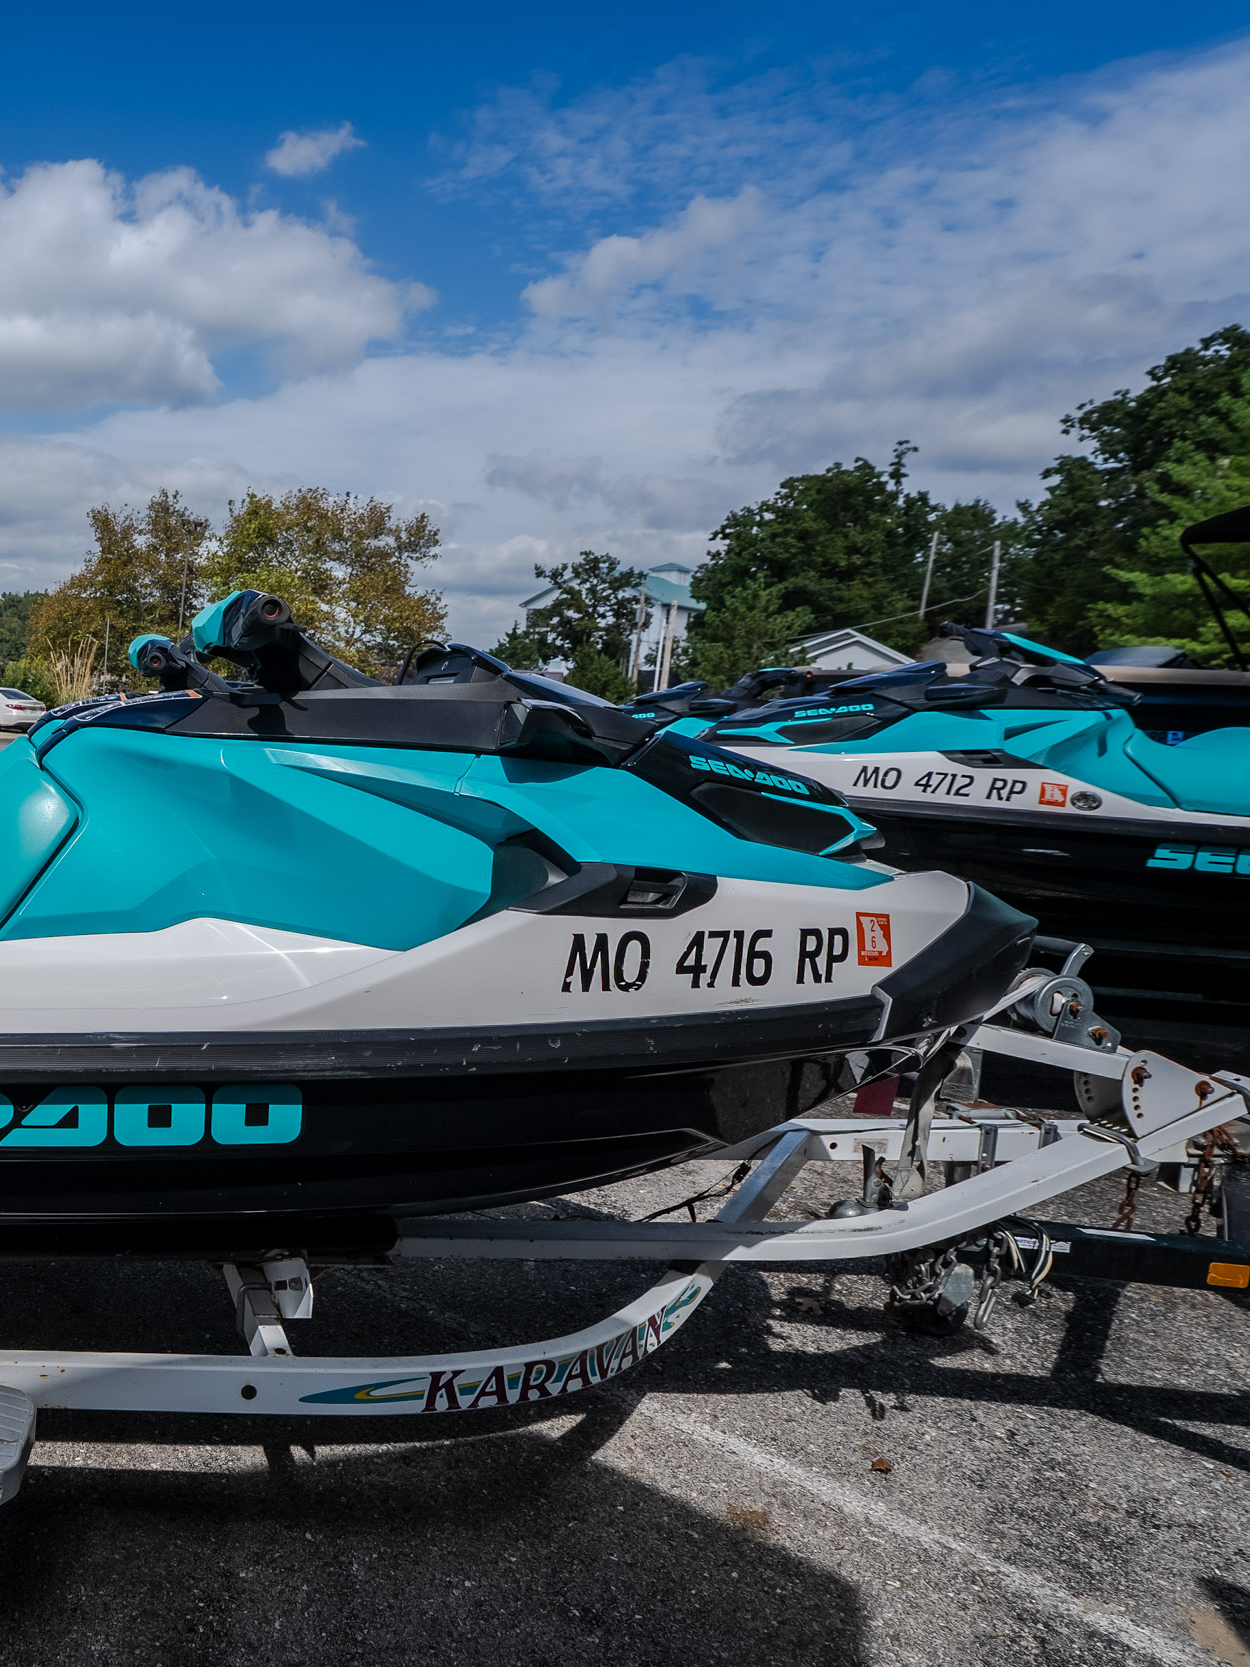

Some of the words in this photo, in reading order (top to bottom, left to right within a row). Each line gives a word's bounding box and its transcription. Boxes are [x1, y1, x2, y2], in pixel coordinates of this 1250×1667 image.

[852, 765, 902, 790] MO
[914, 771, 974, 798] 4712
[986, 777, 1028, 802] RP
[561, 930, 651, 993] MO
[675, 929, 773, 989] 4716
[796, 927, 849, 984] RP
[420, 1305, 668, 1413] KARAVAN
